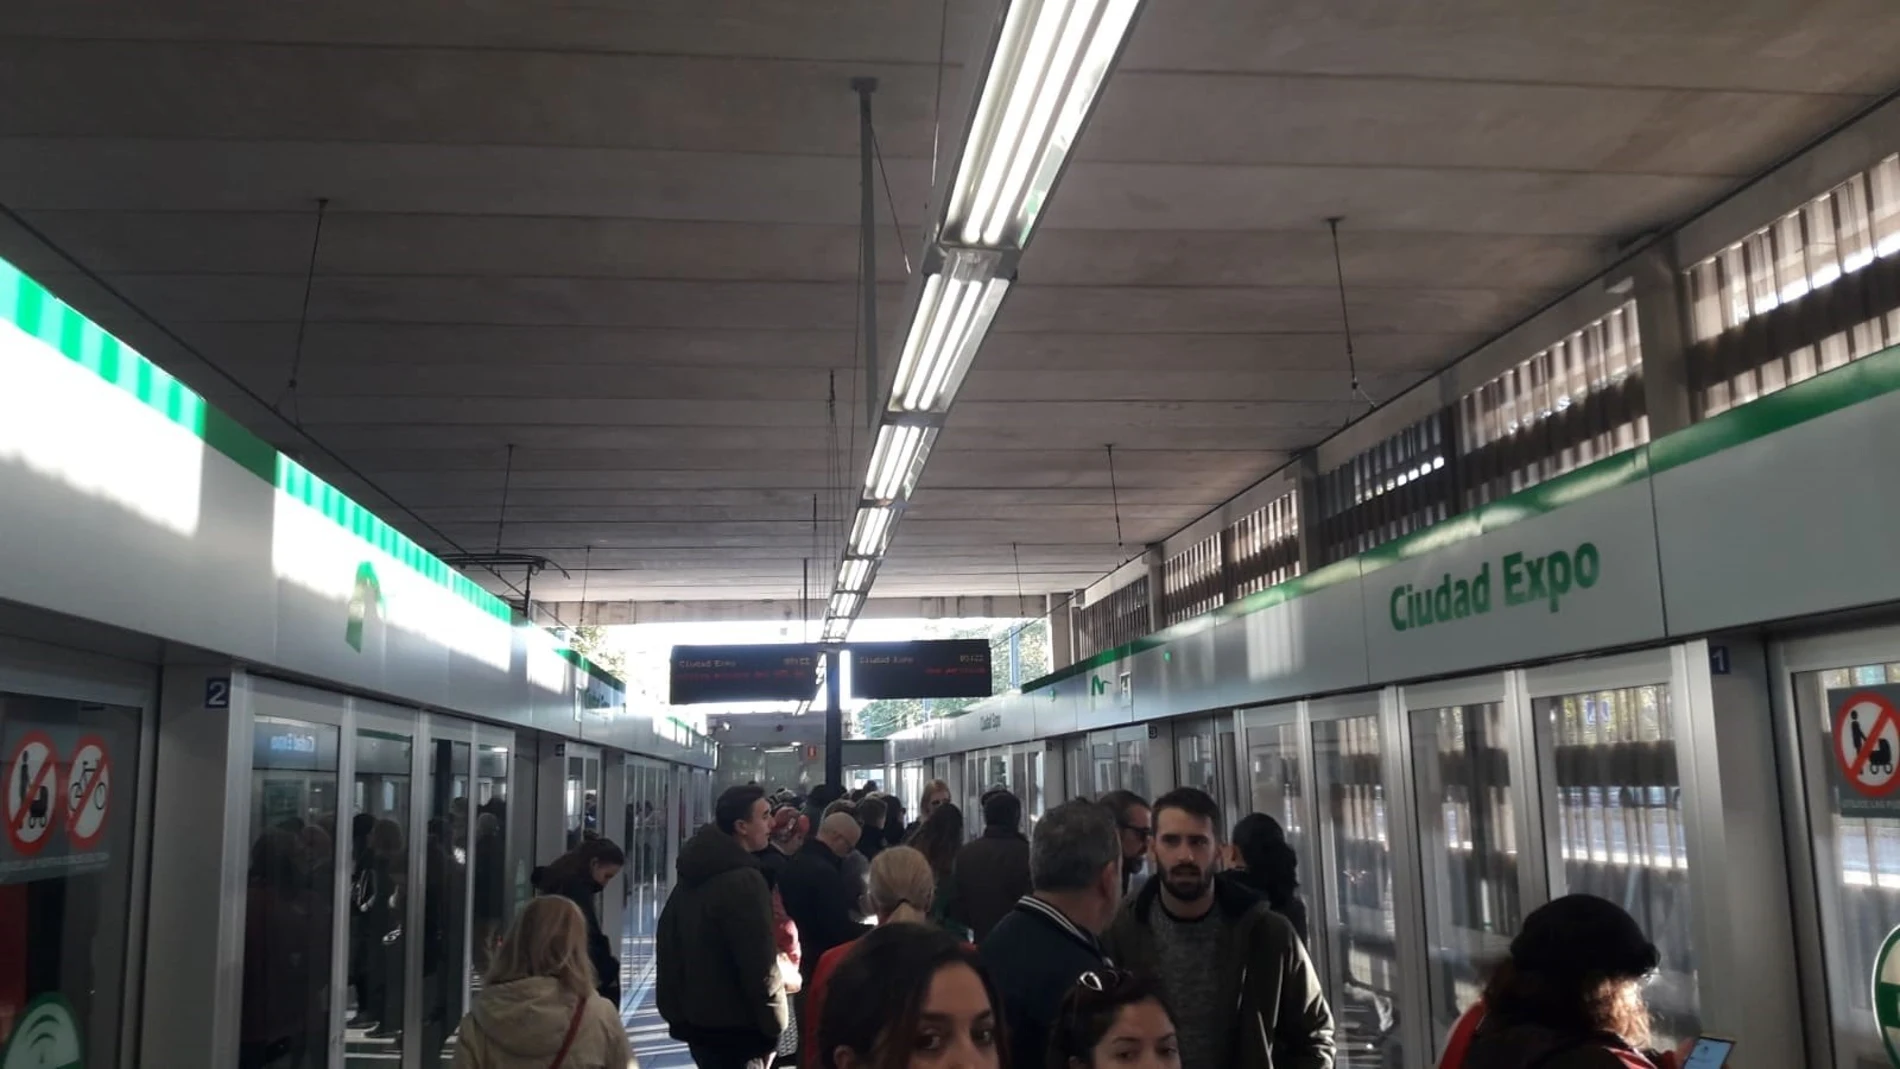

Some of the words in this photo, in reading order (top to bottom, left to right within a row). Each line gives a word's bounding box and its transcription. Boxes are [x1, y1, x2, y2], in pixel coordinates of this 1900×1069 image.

[1390, 562, 1490, 631] Ciudad
[1503, 542, 1599, 613] Expo
[1712, 648, 1724, 671] 1
[208, 682, 226, 705] 2
